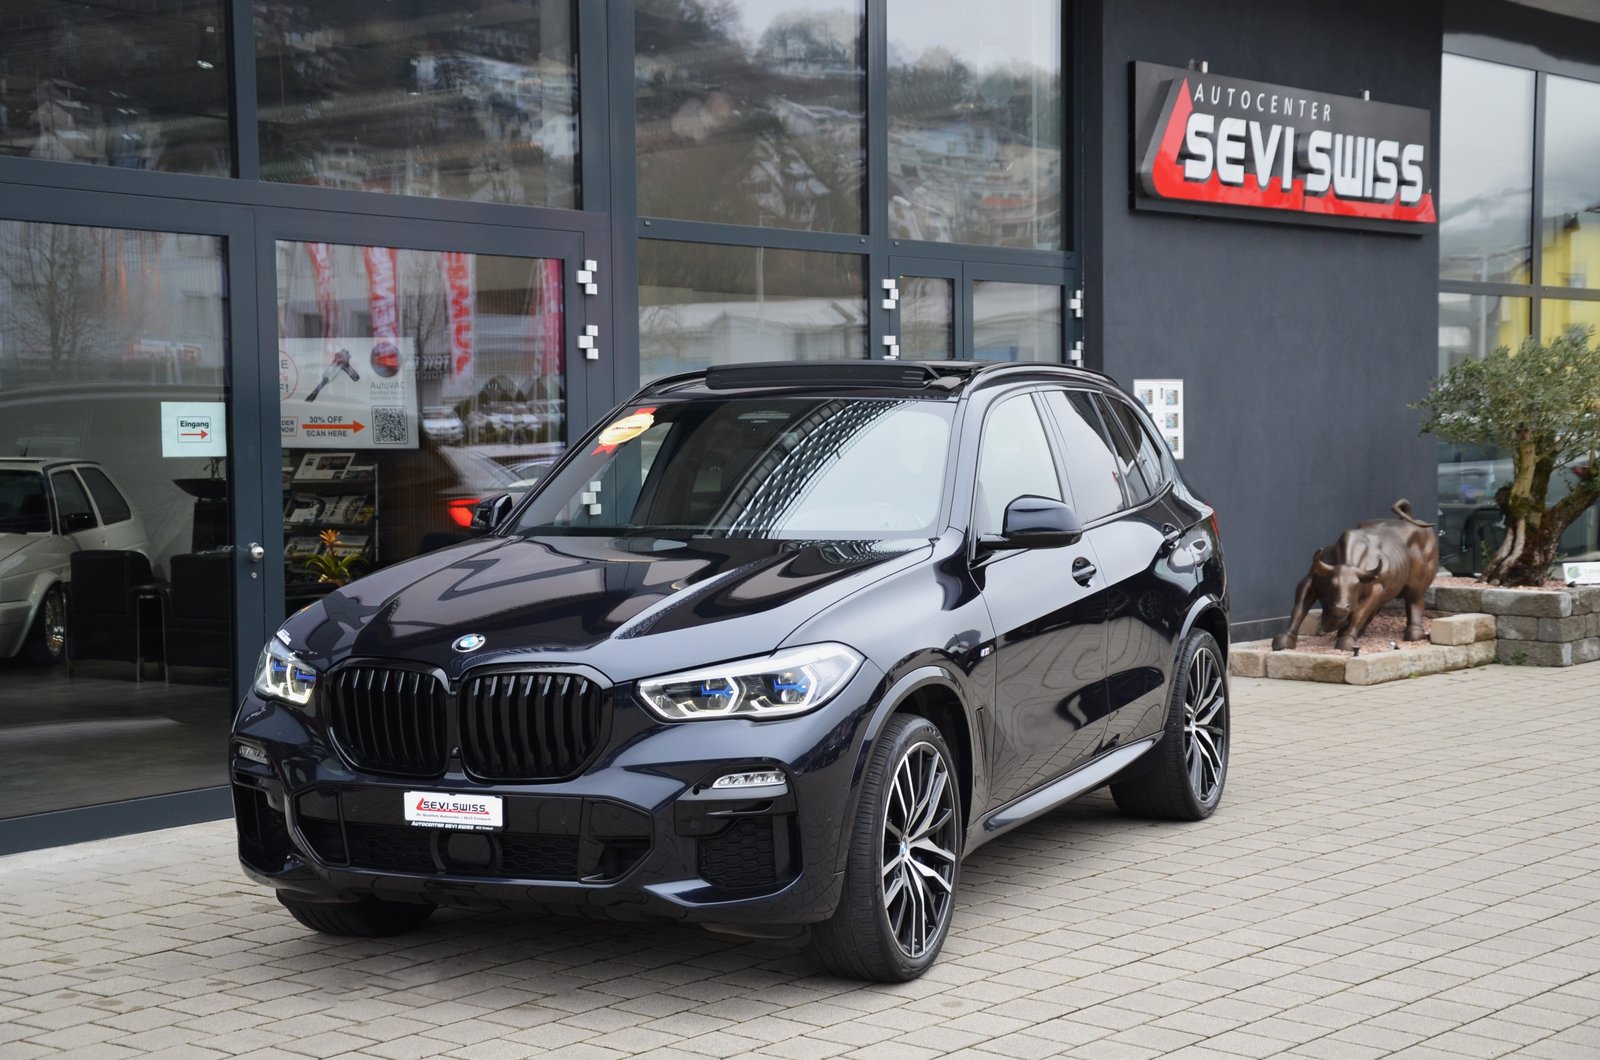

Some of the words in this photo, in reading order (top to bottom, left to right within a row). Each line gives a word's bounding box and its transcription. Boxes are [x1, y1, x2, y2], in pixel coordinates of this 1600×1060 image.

[1193, 82, 1331, 122] AUTOCENTER
[1183, 112, 1295, 191] SEVI
[1305, 129, 1424, 204] SWISS
[180, 420, 209, 429] Eingang
[423, 800, 449, 810] SEVI
[452, 802, 486, 812] SWISS
